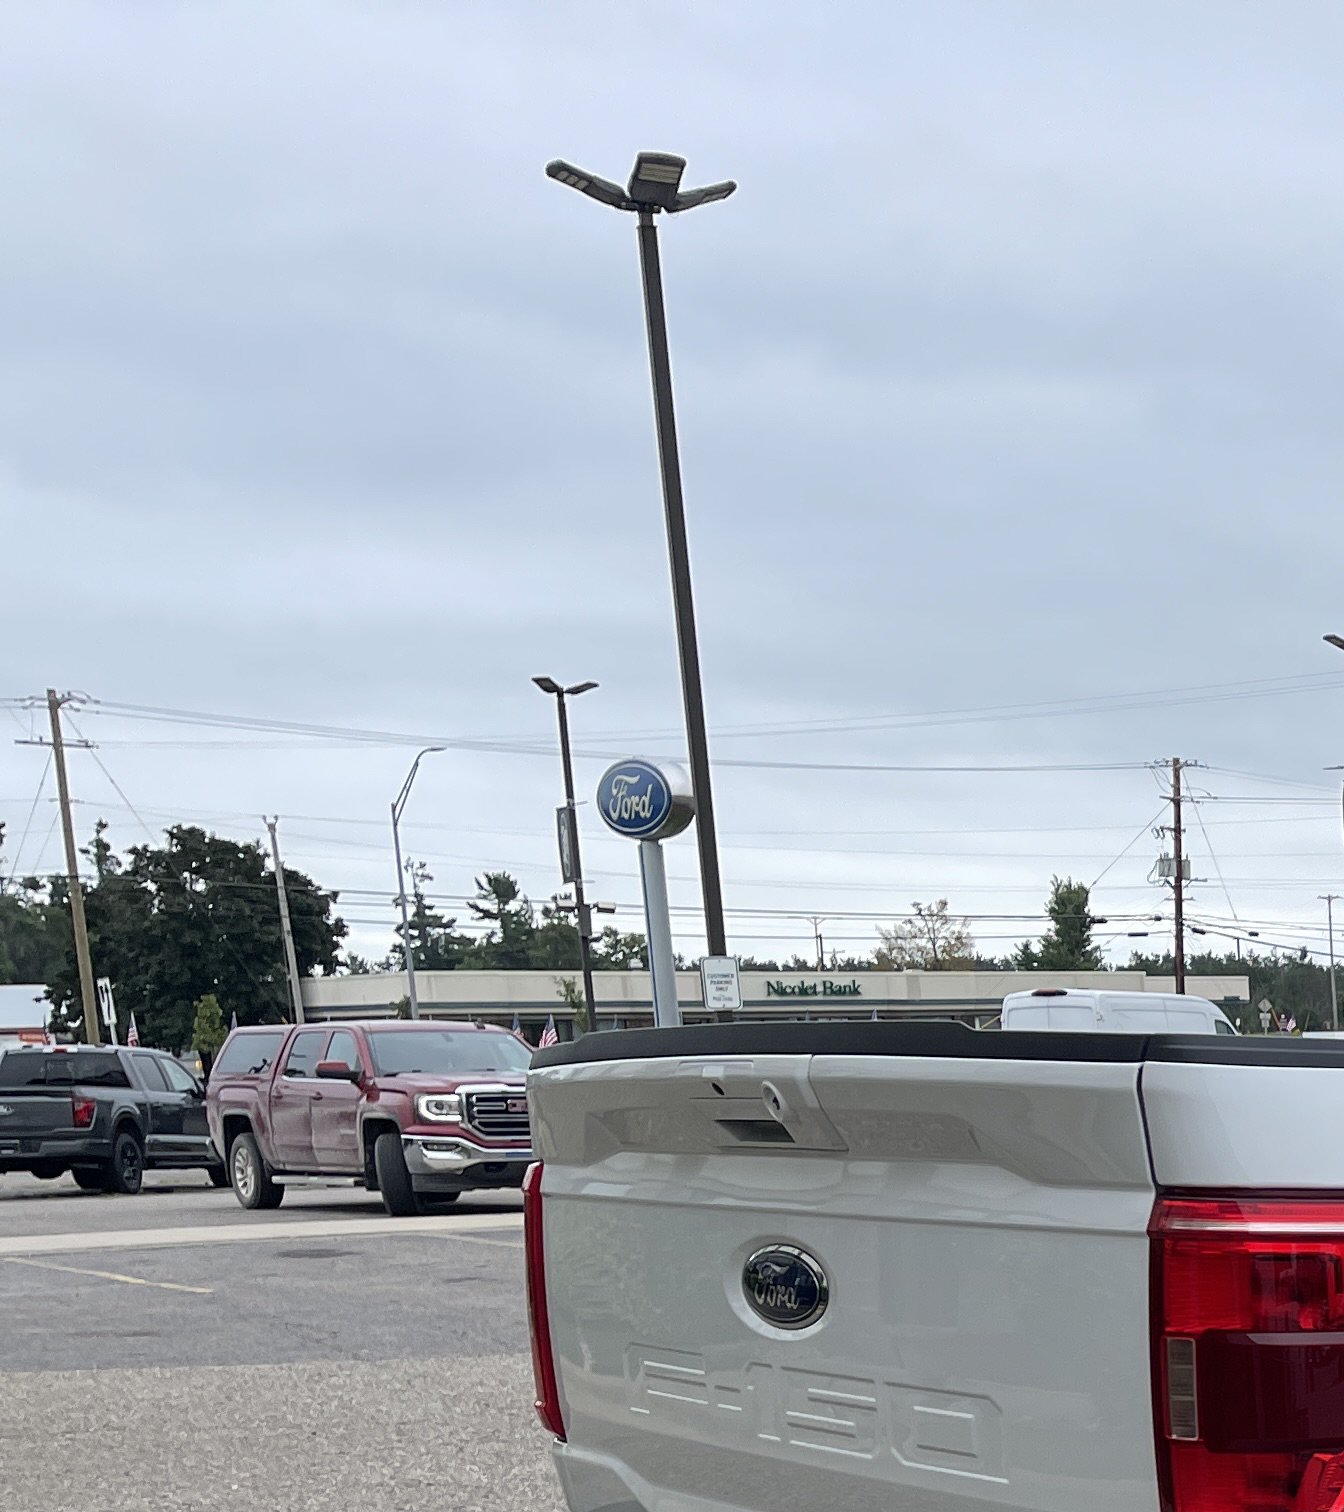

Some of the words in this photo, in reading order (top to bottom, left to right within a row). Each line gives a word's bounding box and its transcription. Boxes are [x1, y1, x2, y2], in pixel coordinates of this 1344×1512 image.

[608, 774, 654, 821] Ford
[766, 980, 818, 996] Nicolet
[822, 979, 862, 996] Bank
[754, 1261, 800, 1310] Ford
[622, 1341, 1010, 1485] F-150
